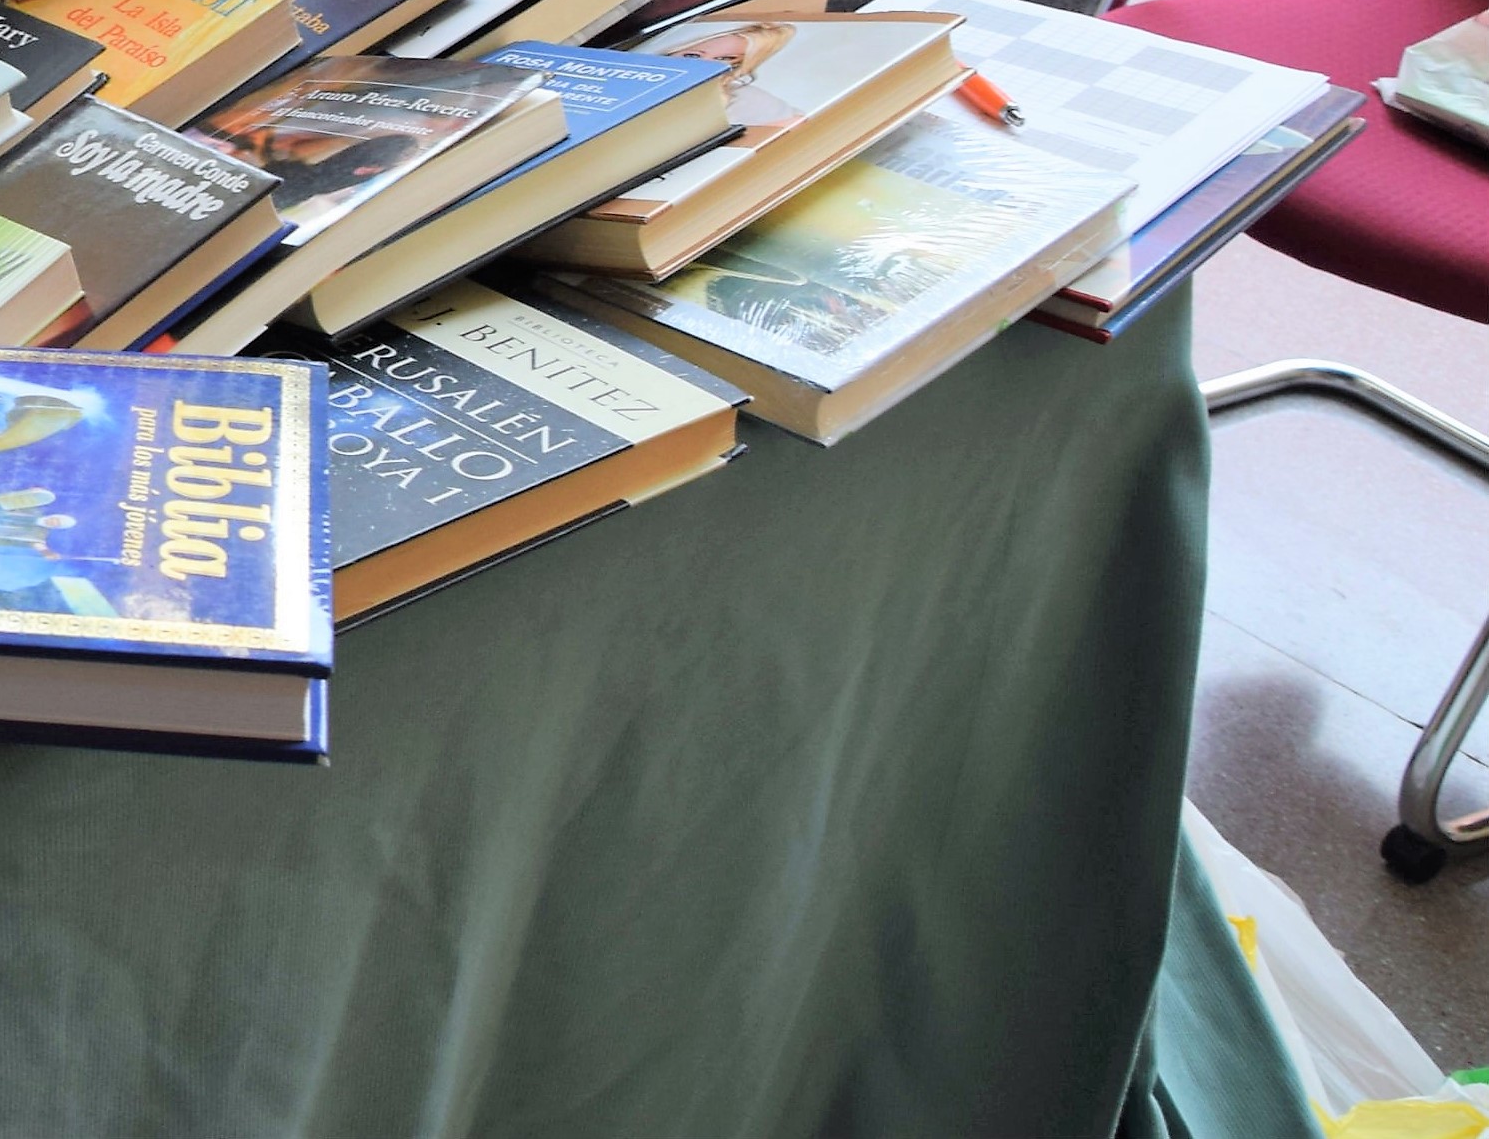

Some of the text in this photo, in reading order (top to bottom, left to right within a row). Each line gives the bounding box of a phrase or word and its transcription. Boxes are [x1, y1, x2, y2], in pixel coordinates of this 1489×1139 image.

[66, 7, 169, 69] del Paraíso
[144, 10, 183, 39] Isla
[497, 53, 668, 84] ROSA MONTERO
[572, 82, 606, 95] DEL
[288, 107, 375, 129] francotirador
[368, 118, 435, 137] paciente
[301, 89, 479, 120] Arturo Pérez-Reverte
[560, 91, 620, 107] RENTE
[55, 128, 226, 222] Soy la madre
[134, 132, 251, 194] Carmen Conde
[514, 315, 621, 369] BIBLIOTECA
[459, 324, 661, 422] BENÍTEZ
[328, 383, 514, 482] BALLO
[328, 431, 424, 490] OYA
[117, 405, 165, 568] para los más jóvenes
[158, 399, 274, 581] Biblia
